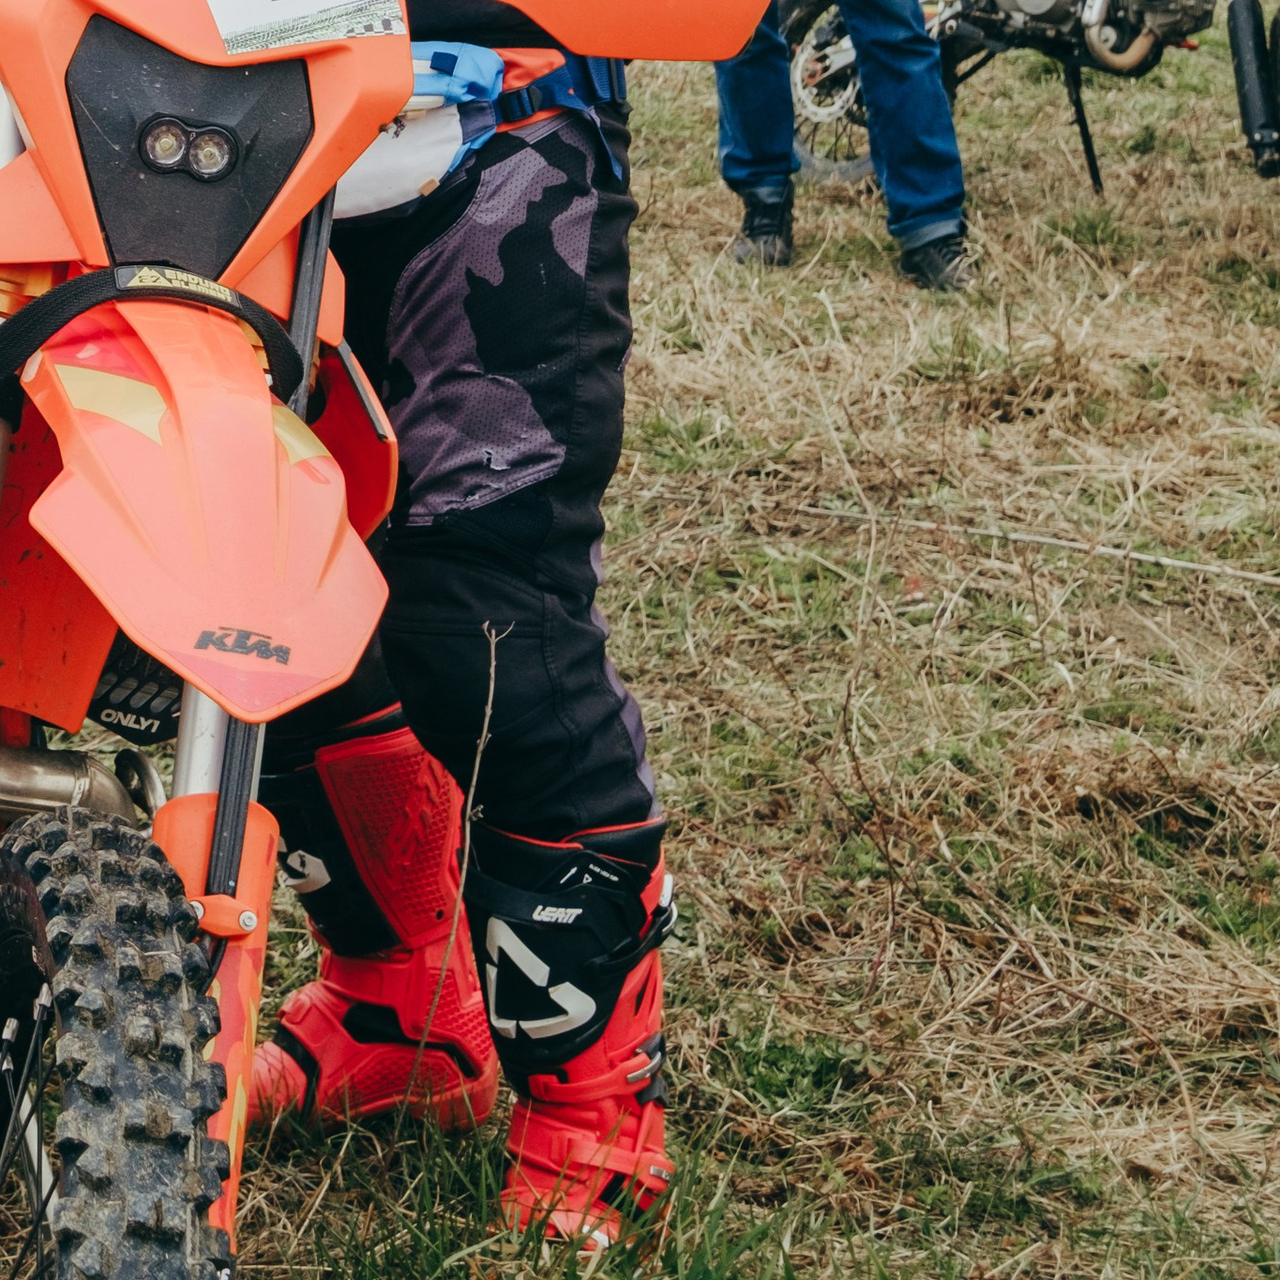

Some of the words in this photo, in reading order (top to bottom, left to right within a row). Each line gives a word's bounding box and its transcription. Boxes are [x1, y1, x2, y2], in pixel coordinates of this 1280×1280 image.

[164, 269, 232, 296] ENDURO
[172, 280, 233, 303] ELEMENT
[193, 626, 291, 666] KTM
[100, 708, 160, 733] ONLY1
[532, 905, 583, 924] LEATT
